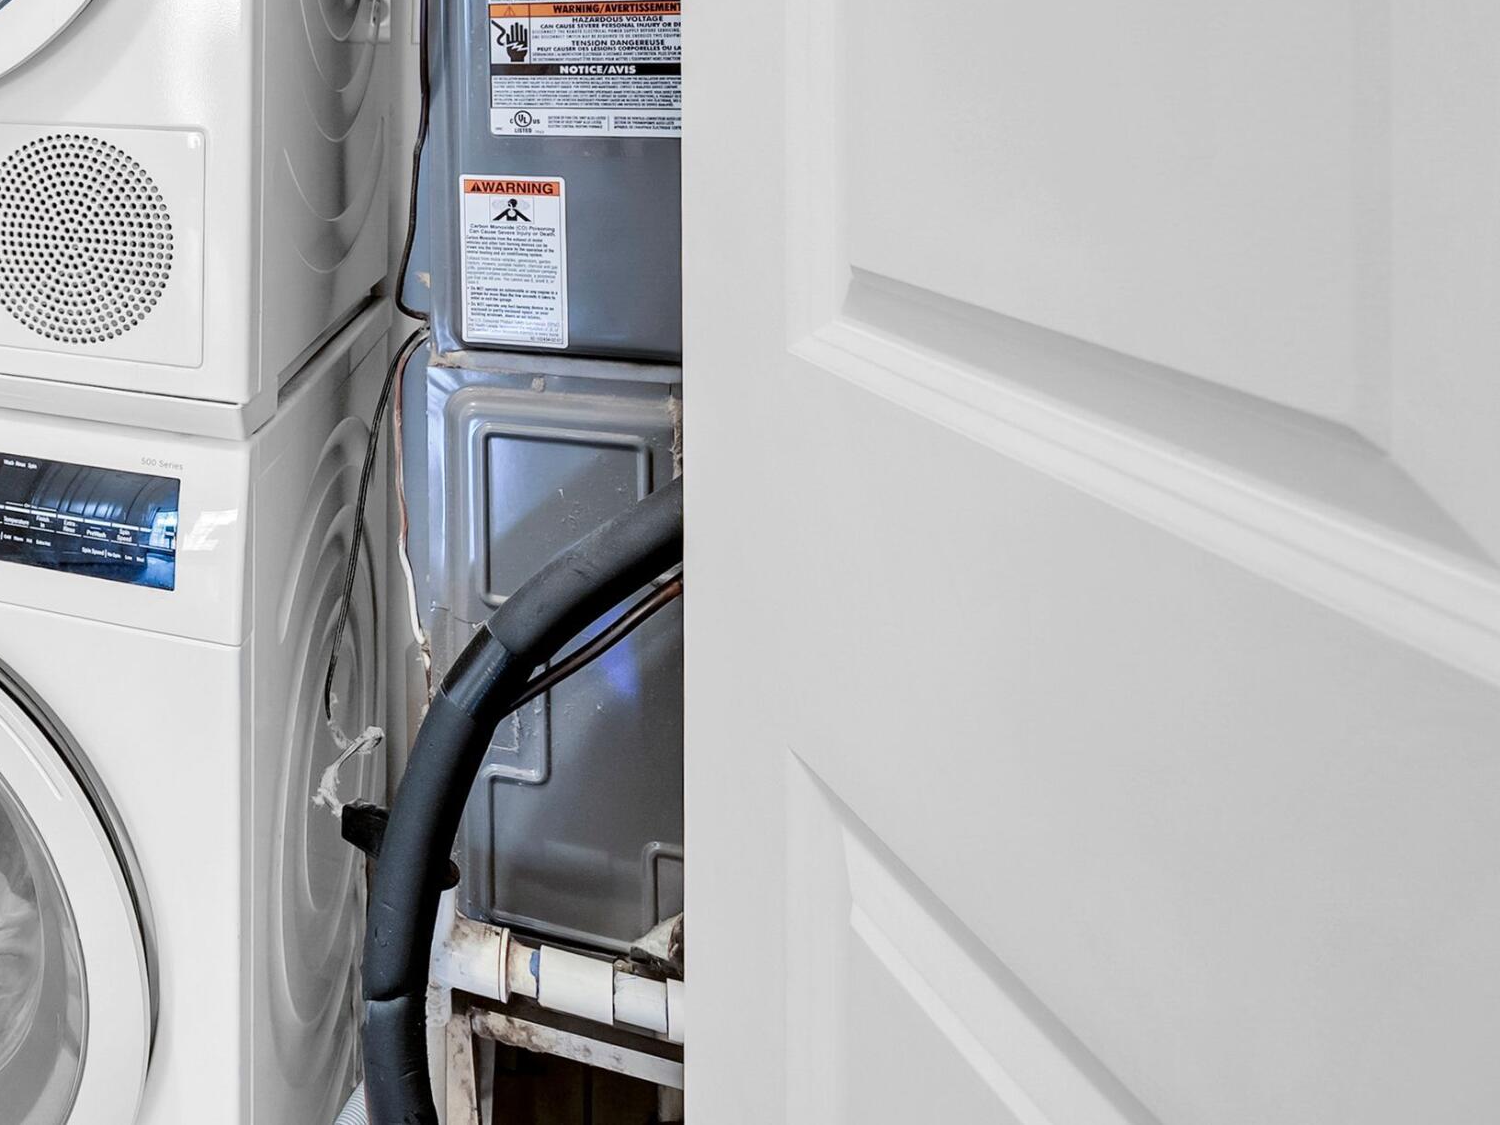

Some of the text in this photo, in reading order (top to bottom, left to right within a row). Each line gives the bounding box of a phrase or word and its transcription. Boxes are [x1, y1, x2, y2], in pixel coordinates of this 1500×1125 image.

[560, 66, 636, 74] NOTICE/AVIS
[482, 182, 553, 194] WARNING
[141, 457, 183, 470] 500 Series
[4, 516, 29, 525] Temperature
